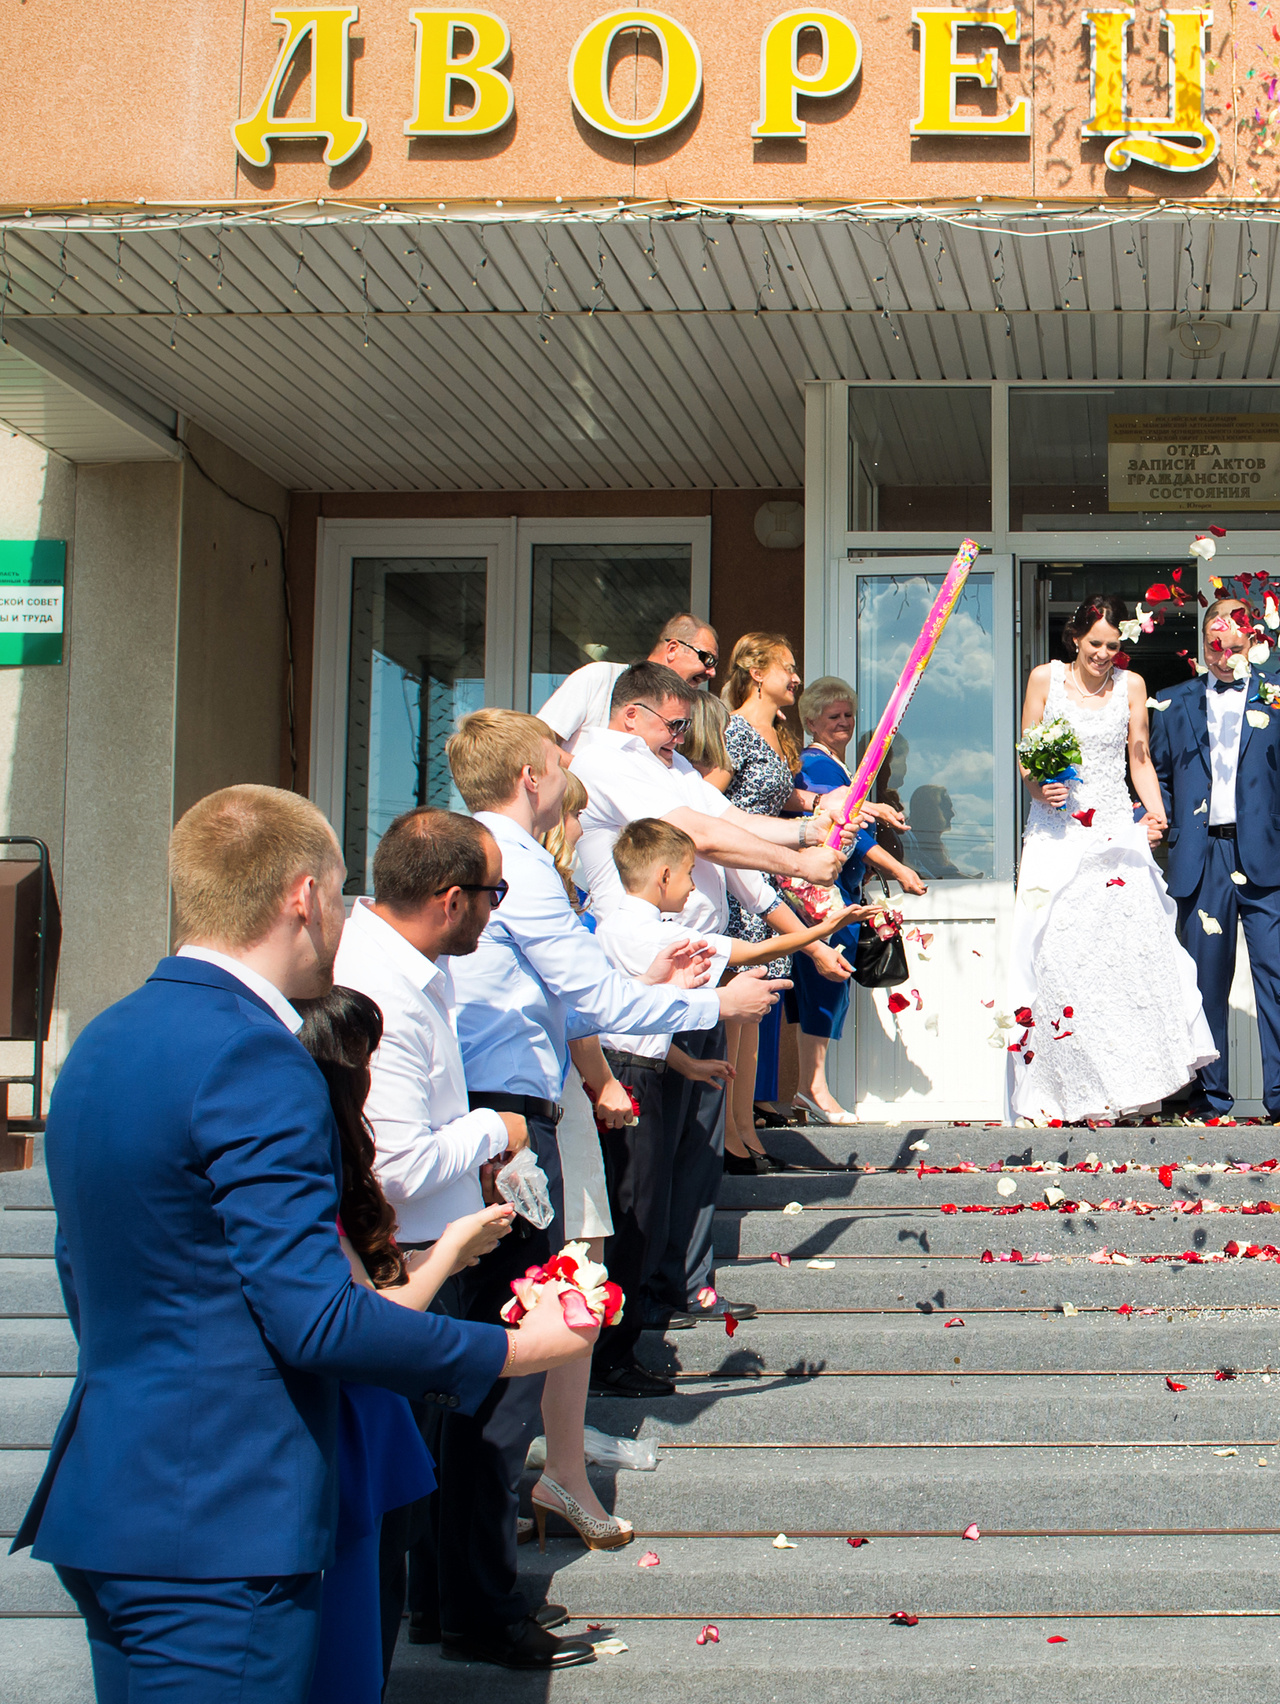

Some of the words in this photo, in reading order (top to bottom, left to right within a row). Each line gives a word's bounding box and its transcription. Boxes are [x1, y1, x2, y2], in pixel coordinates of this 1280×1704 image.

[230, 6, 1220, 174] ДВОРЕЦ
[1166, 444, 1222, 458] ОТДЕЛ
[1127, 459, 1196, 471] ЗАПИСИ
[1211, 458, 1267, 470] АКТОВ
[1127, 472, 1261, 486] ГРАЖДАНСКОГО
[1149, 486, 1251, 499] СОСТОЯНИЯ
[27, 598, 59, 606] СОВЕТ
[11, 614, 19, 622] И
[22, 614, 54, 623] ТРУДА
